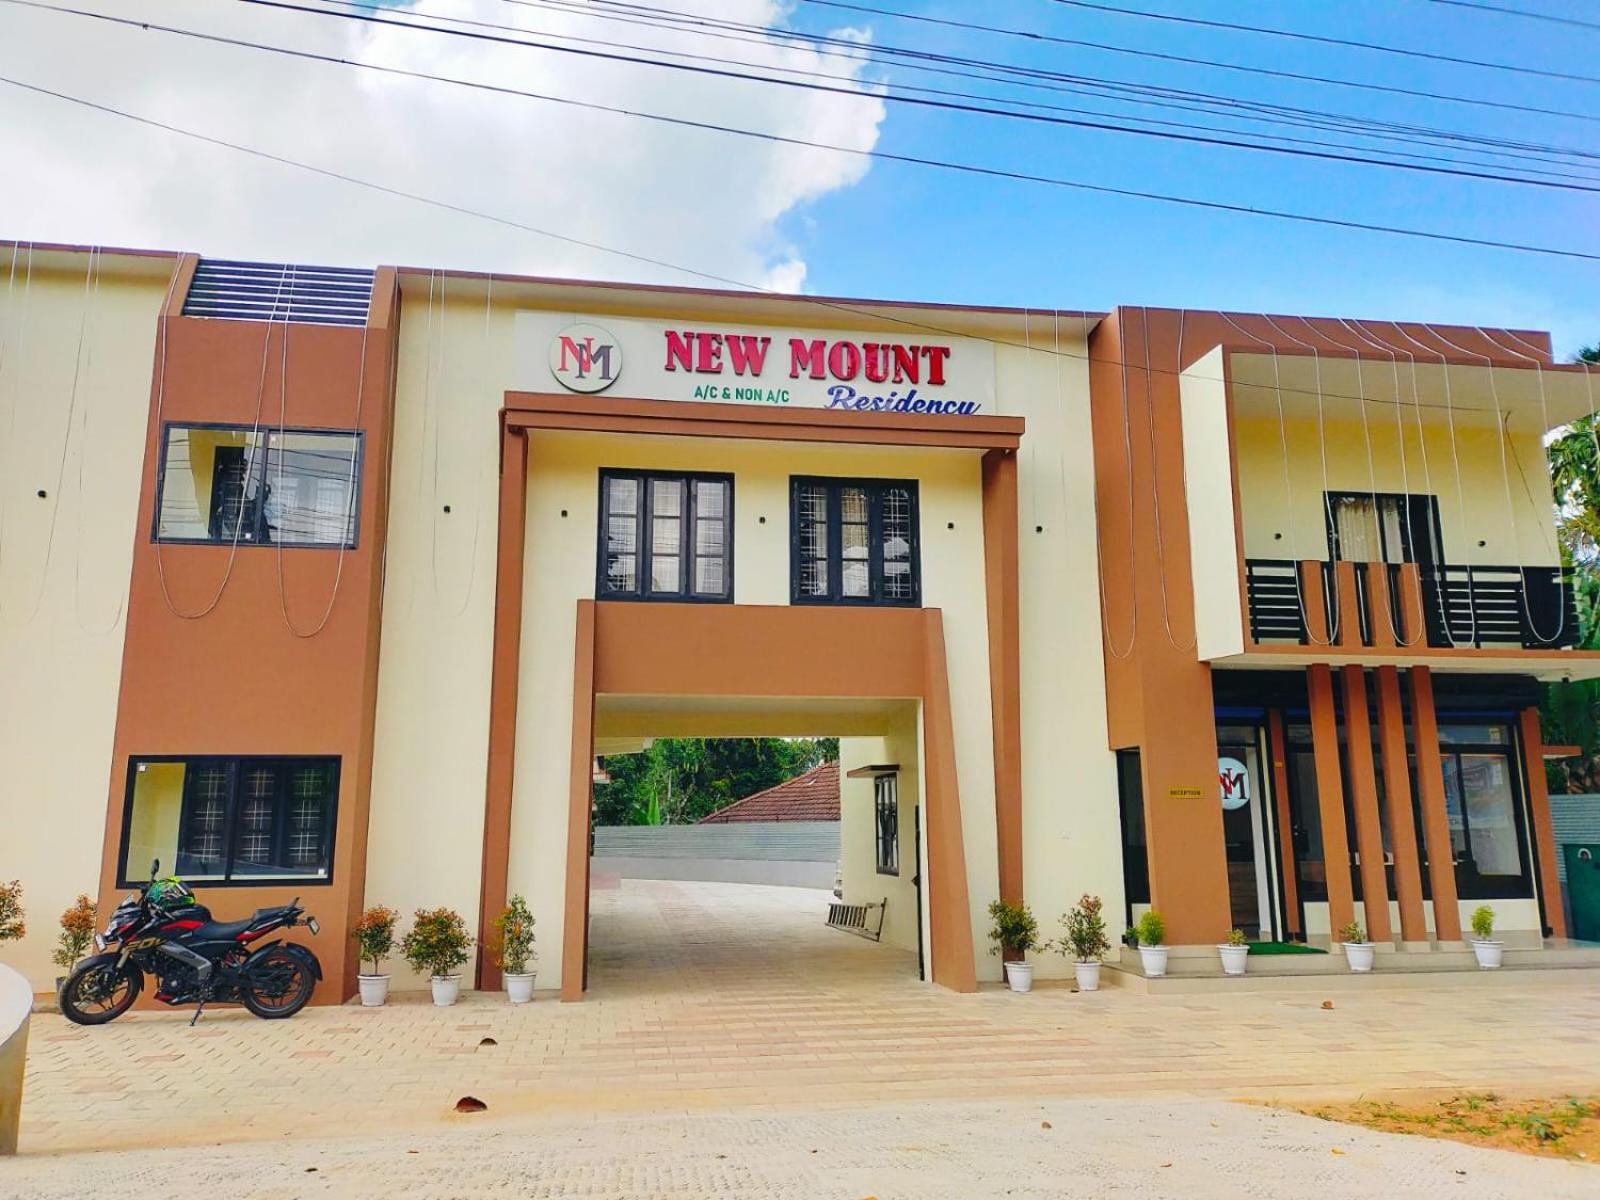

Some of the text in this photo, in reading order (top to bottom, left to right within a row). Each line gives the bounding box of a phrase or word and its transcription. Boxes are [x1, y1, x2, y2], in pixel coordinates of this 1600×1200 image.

[664, 330, 951, 385] NEW MOUNT
[694, 385, 790, 404] A/C & NON A/C
[824, 384, 982, 415] Residency
